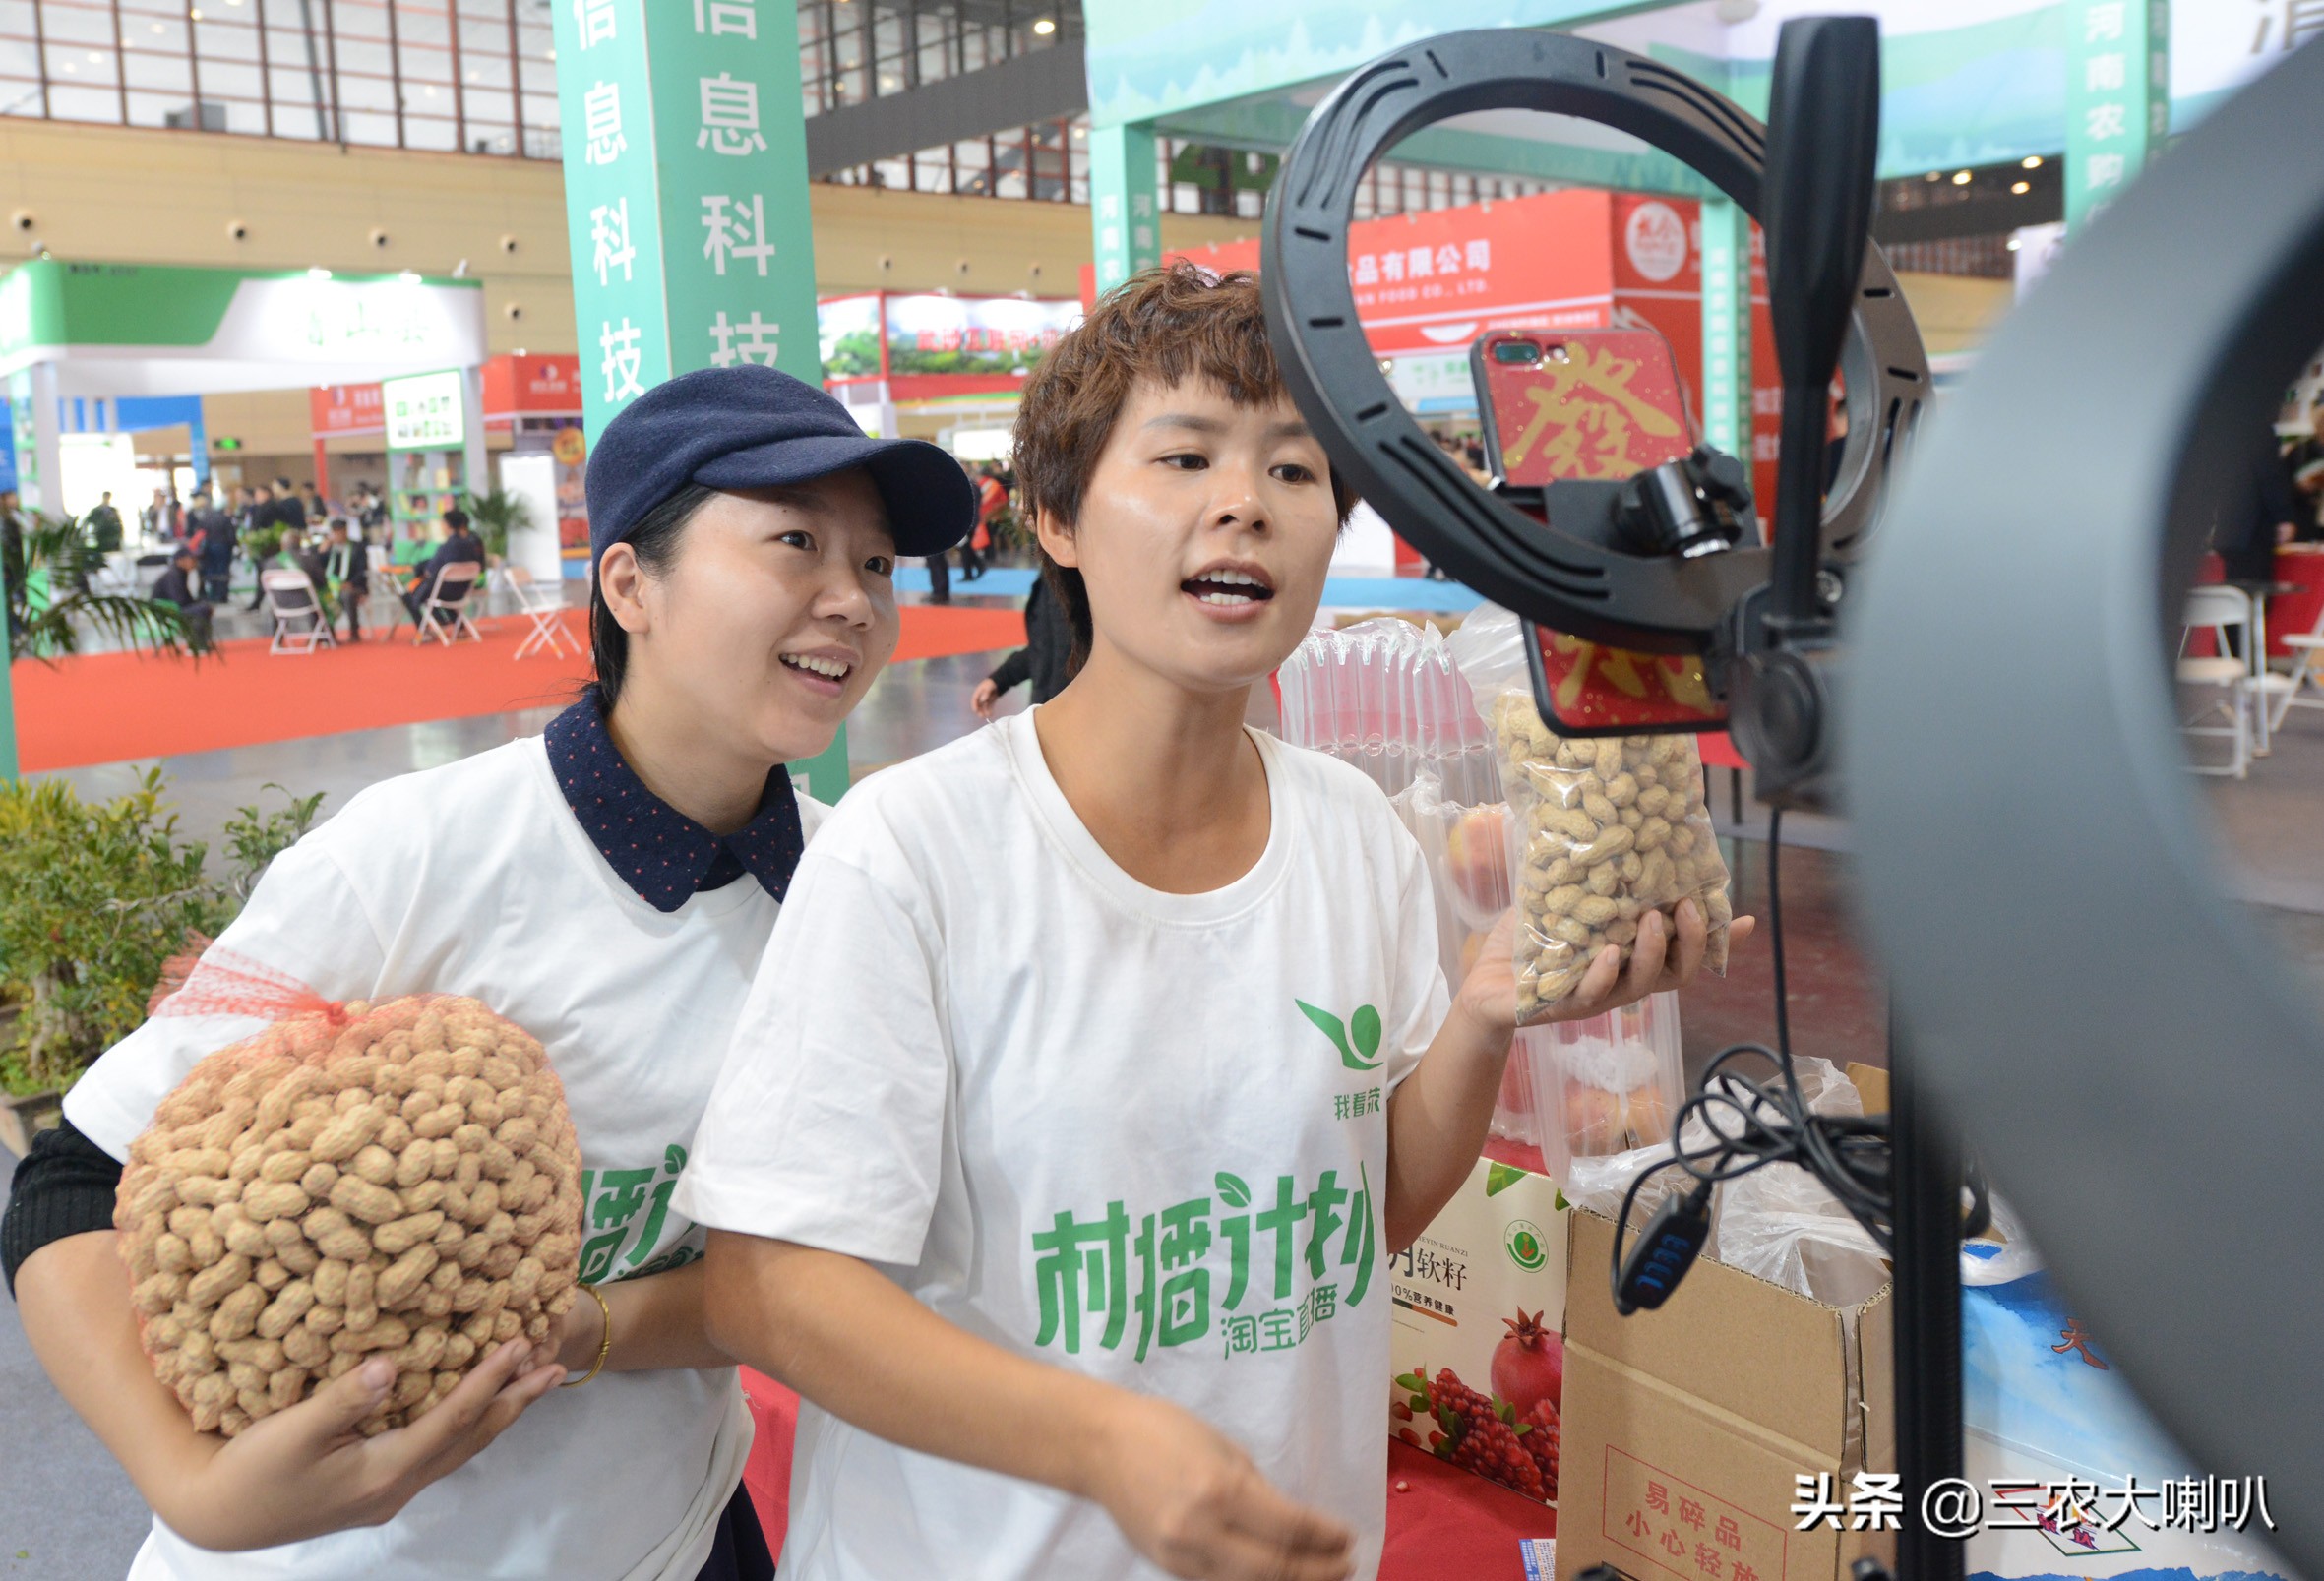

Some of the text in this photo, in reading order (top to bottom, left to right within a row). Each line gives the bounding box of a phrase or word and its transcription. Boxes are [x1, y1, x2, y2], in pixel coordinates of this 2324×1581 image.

[573, 0, 644, 403] 信息科技
[1348, 239, 1491, 286] 品有限公司
[1032, 1160, 1375, 1364] 村播计划
[1439, 1242, 1468, 1257] RUANZI
[1220, 1283, 1338, 1360] 淘宝直播
[1390, 1282, 1455, 1317] 0%营养健康
[1645, 1480, 1742, 1552] 易碎品
